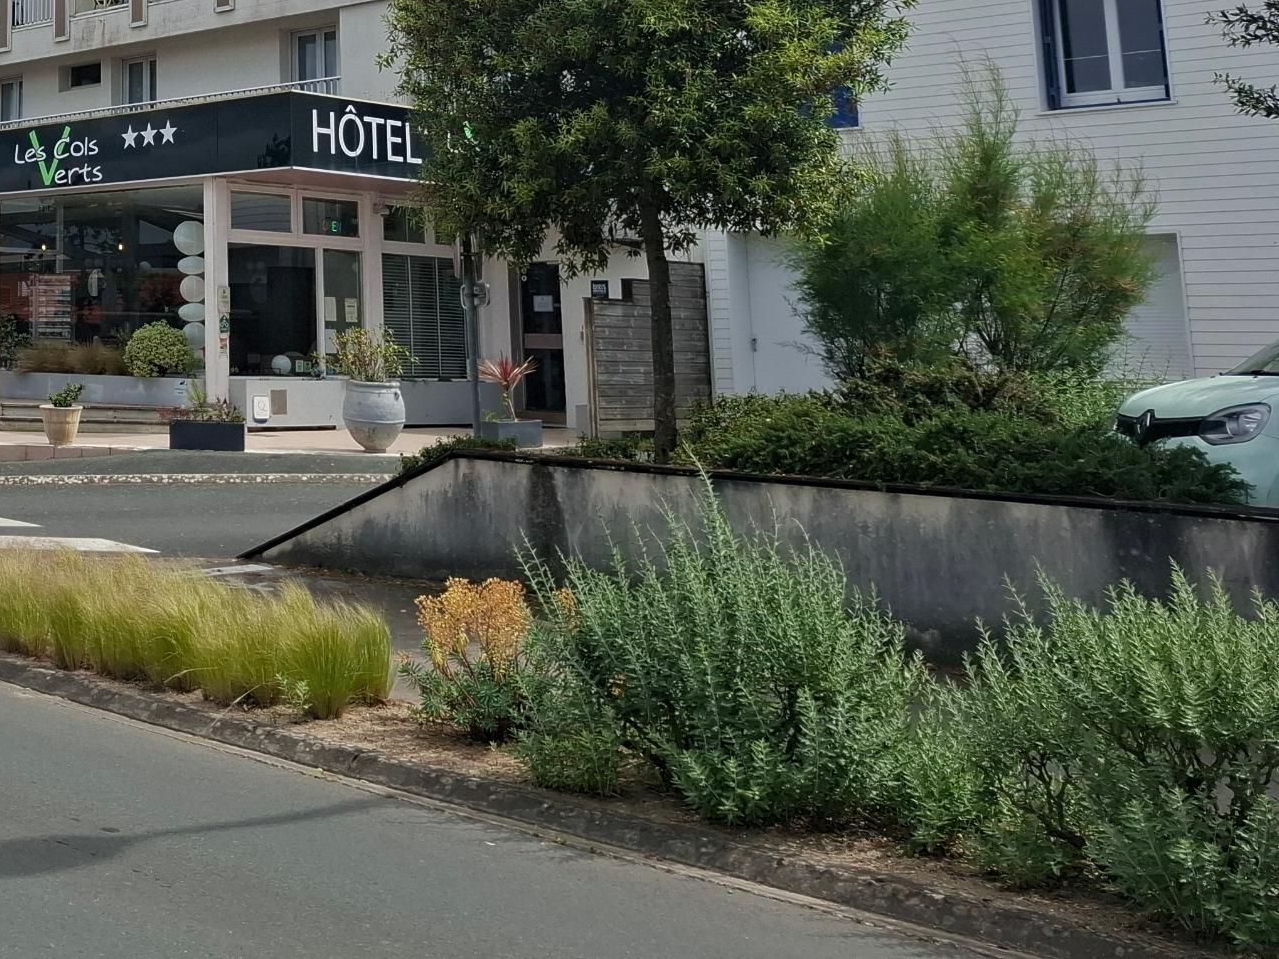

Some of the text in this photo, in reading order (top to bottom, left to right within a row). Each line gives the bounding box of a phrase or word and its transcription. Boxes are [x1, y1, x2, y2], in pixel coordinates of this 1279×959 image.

[14, 136, 99, 164] Les Cols
[29, 126, 103, 186] Verts
[312, 104, 422, 164] HÔTEL
